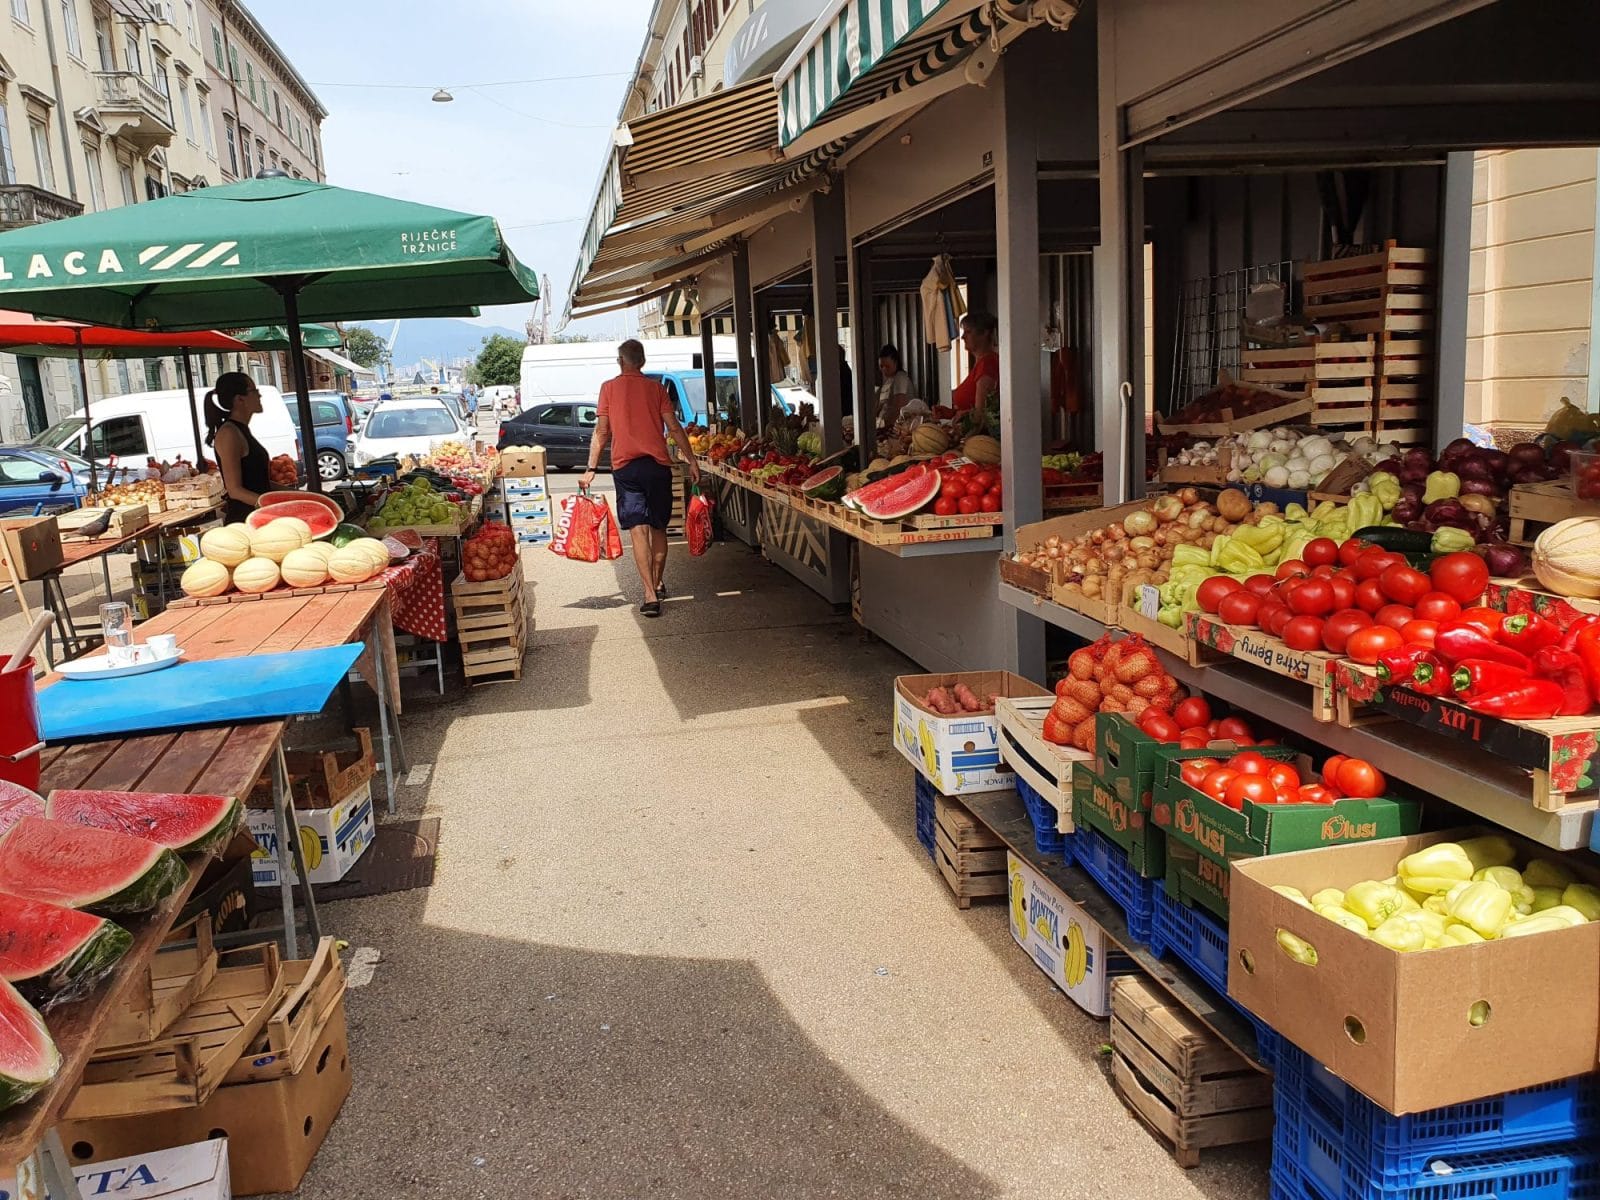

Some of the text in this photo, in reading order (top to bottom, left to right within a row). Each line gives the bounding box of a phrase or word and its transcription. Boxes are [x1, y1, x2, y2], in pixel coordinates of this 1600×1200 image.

[401, 229, 457, 242] RIJEČKE
[402, 242, 457, 254] TRŽNICE
[1241, 635, 1310, 680] Extra Berry
[1391, 687, 1431, 713] Quality
[1030, 892, 1060, 949] BONITA
